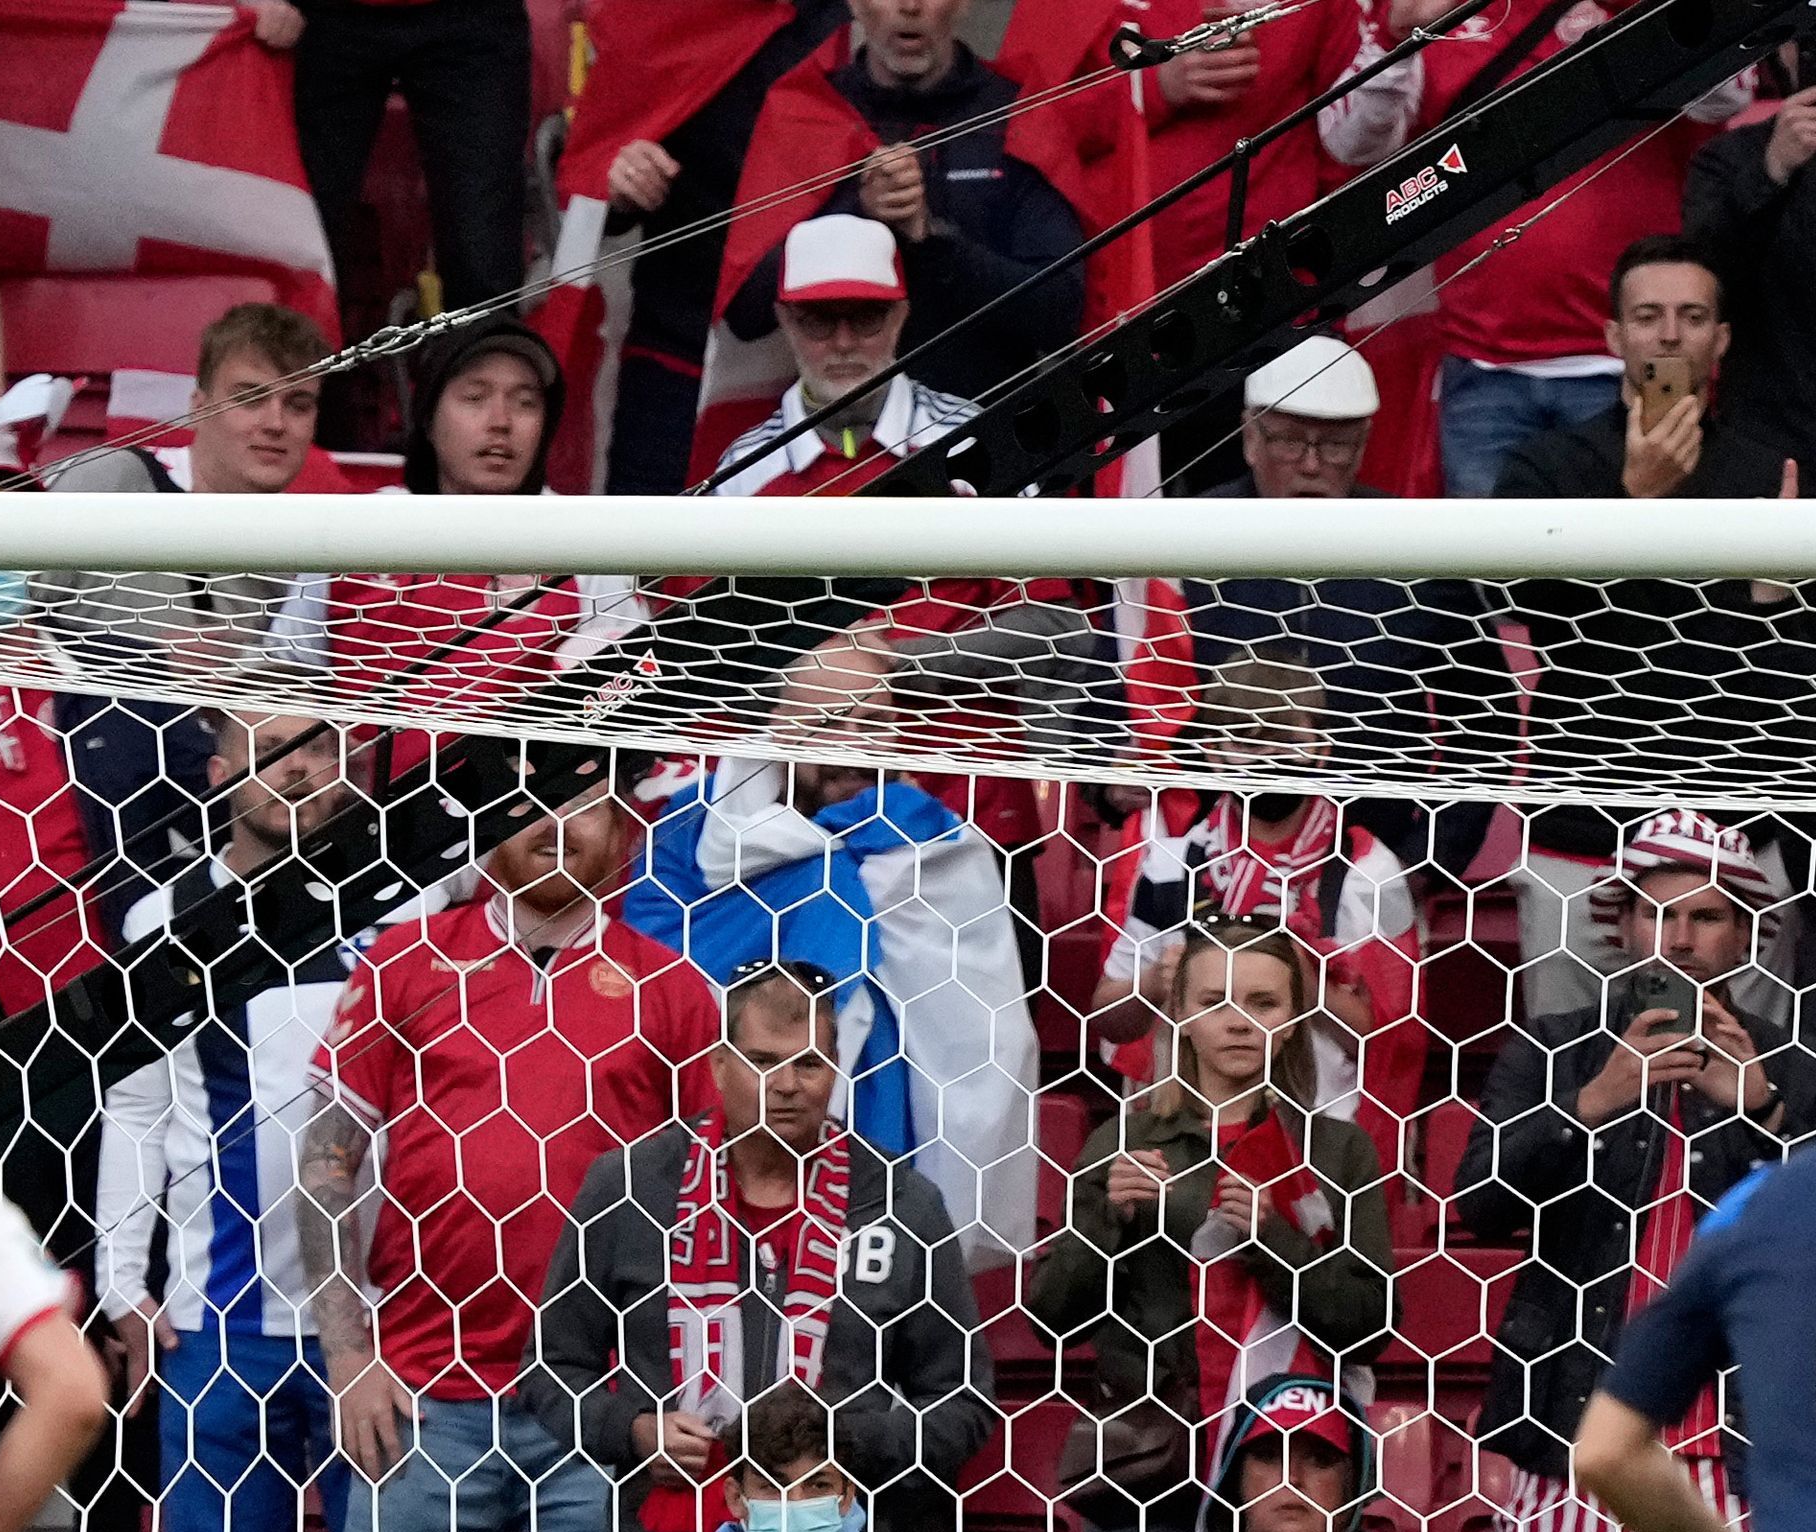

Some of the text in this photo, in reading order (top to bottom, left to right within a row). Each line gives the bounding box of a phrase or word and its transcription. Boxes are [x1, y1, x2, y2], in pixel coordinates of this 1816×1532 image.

[1385, 180, 1449, 225] PRODUCTS
[1386, 166, 1438, 214] ABC
[838, 1224, 896, 1284] B
